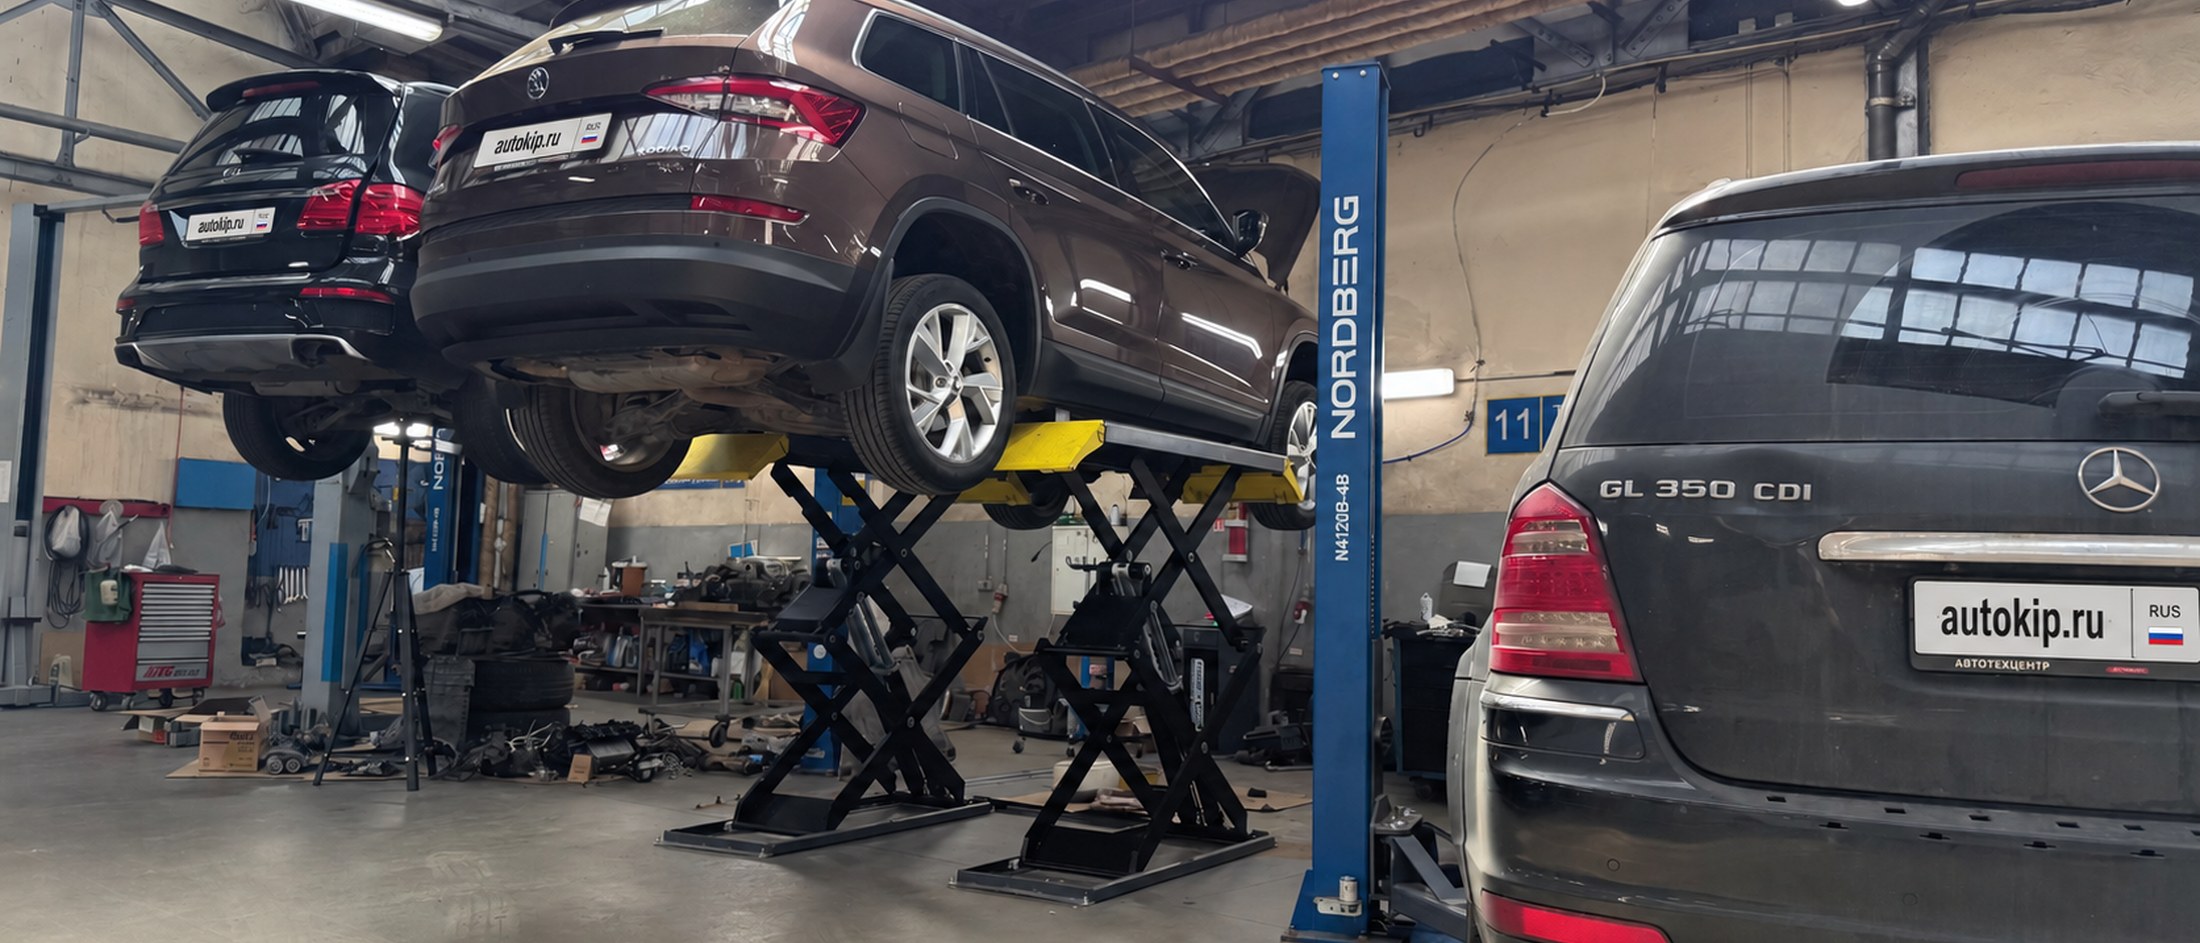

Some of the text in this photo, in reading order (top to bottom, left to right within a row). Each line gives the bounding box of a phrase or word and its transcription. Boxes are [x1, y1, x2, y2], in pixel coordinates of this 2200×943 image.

[494, 130, 562, 155] autokip.ru
[1330, 195, 1360, 439] NORDBERG
[1495, 407, 1530, 441] 11
[1599, 480, 1813, 501] GL 350 CDI
[1335, 473, 1350, 562] N4120B-4B
[1940, 597, 2105, 648] autokip.ru
[2148, 604, 2182, 619] RUS
[1954, 658, 2051, 672] АВТОТЕХЦЕНТР
